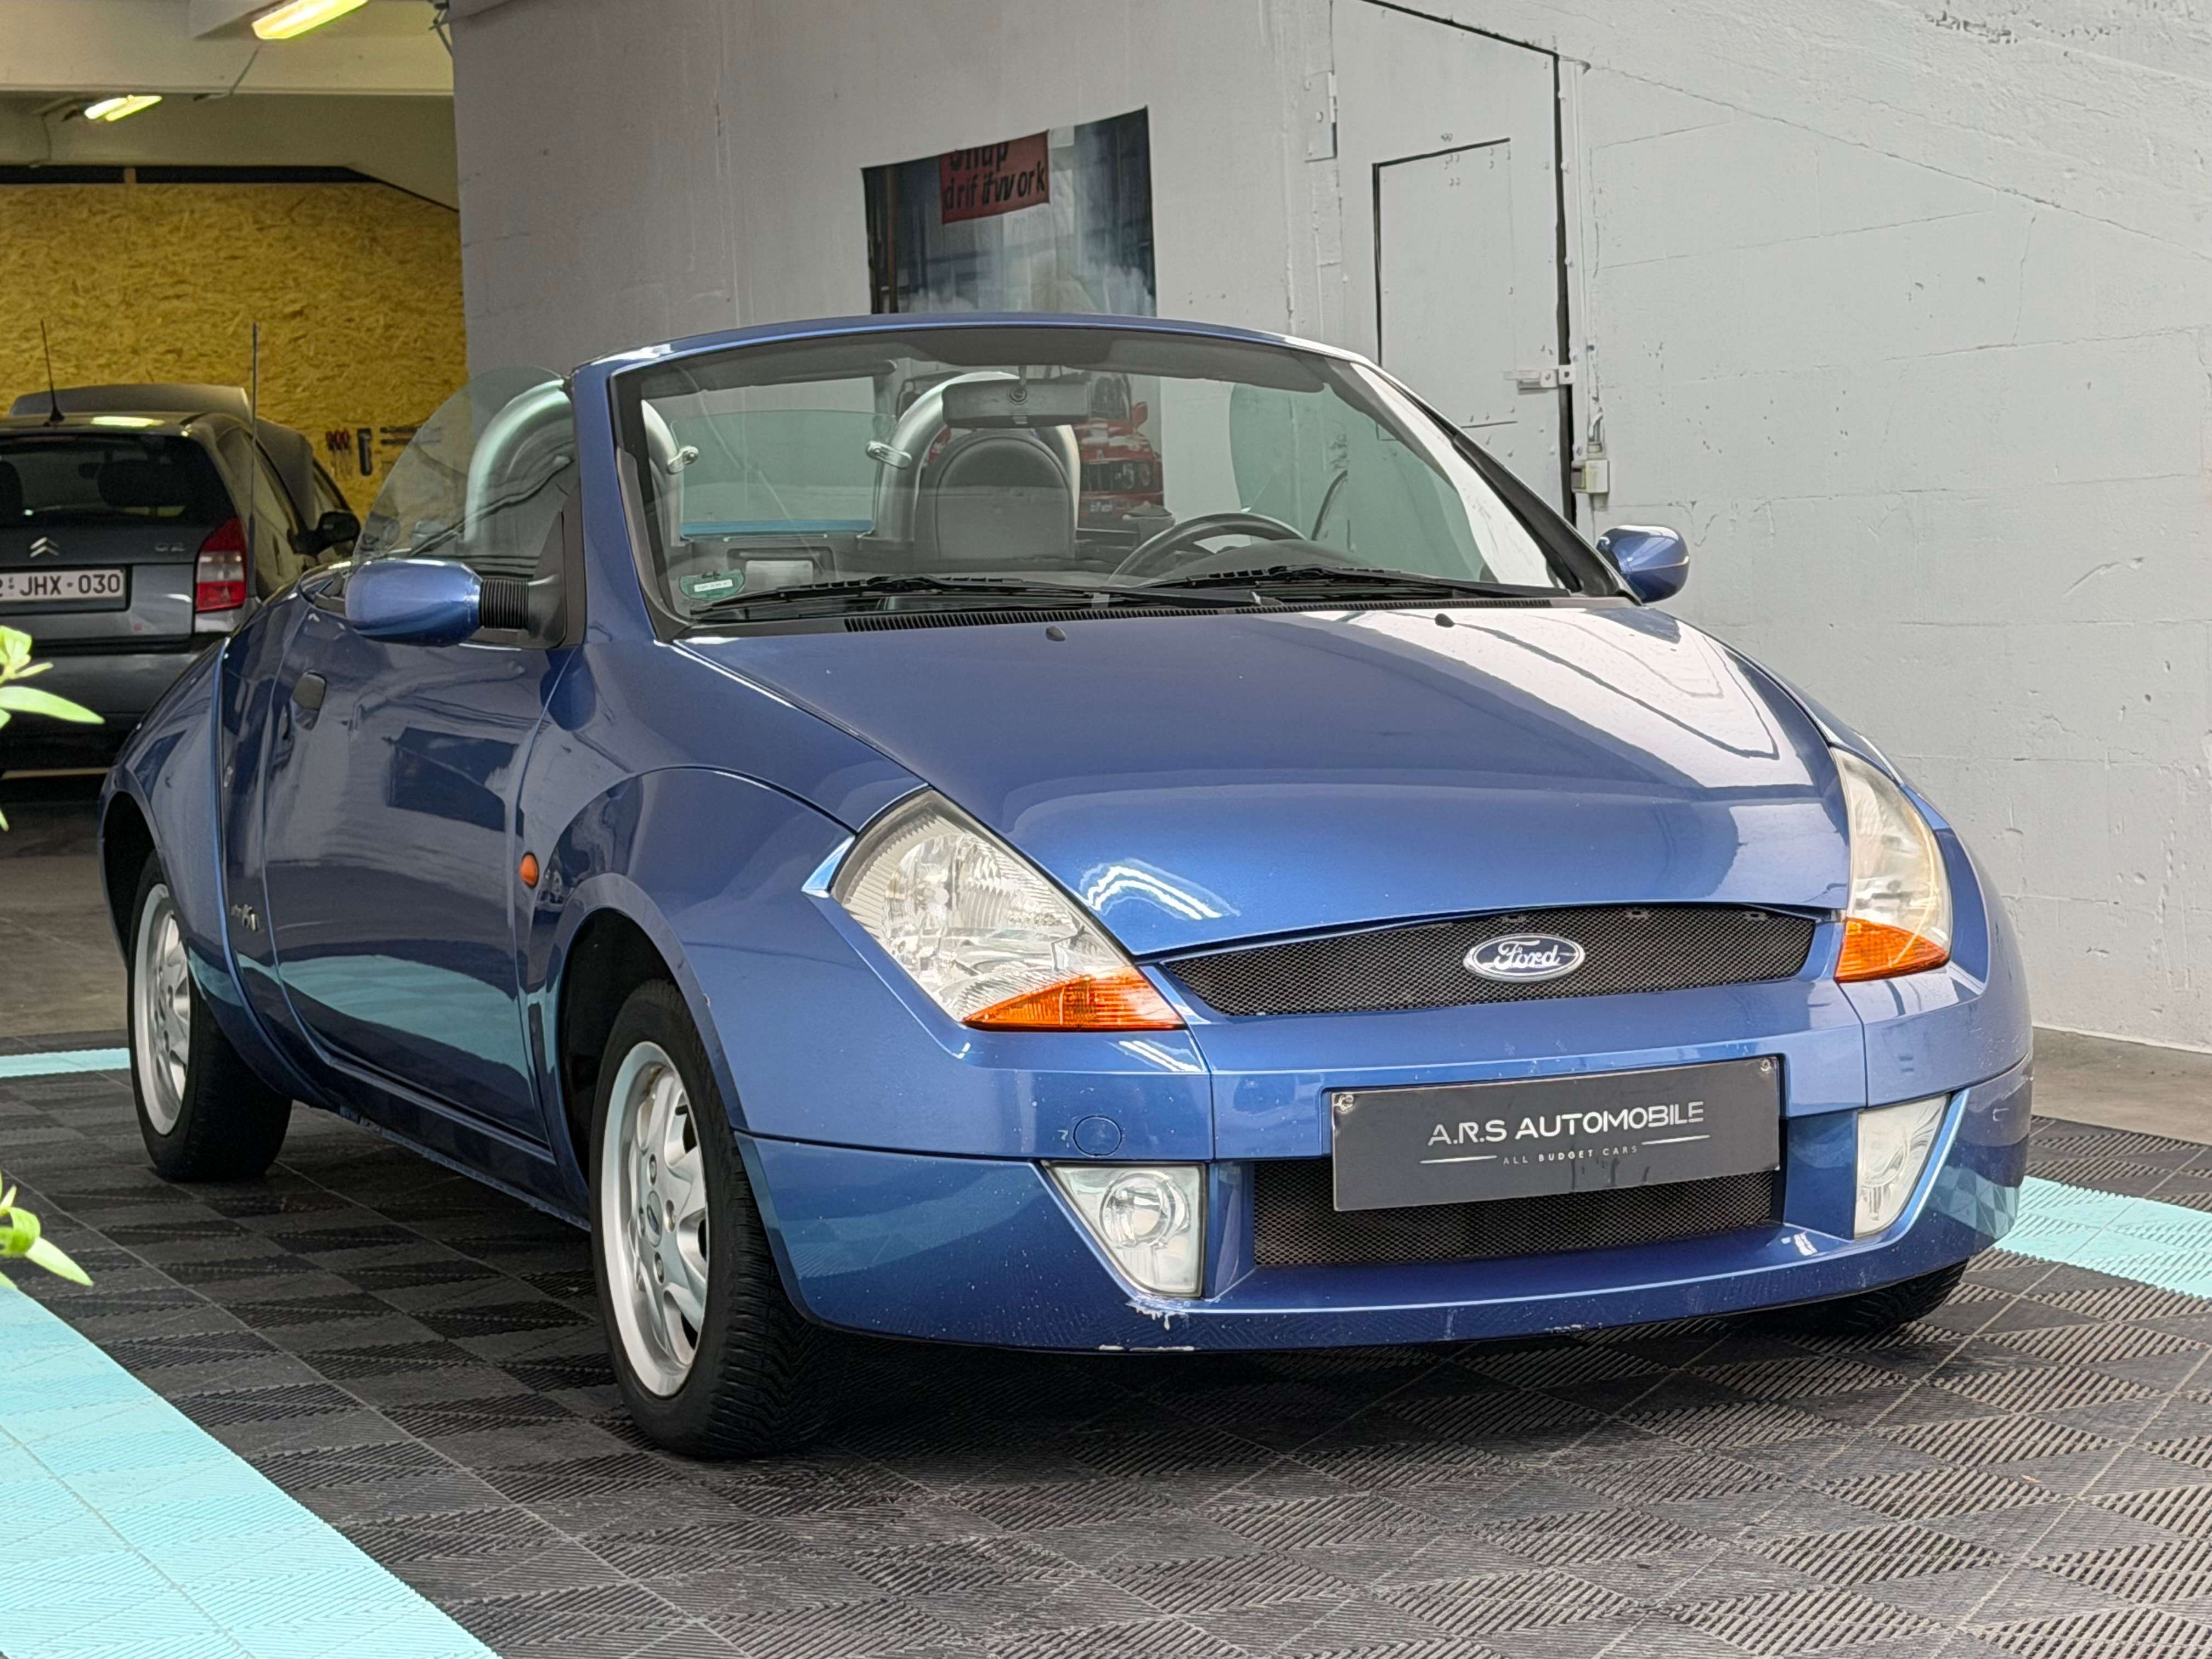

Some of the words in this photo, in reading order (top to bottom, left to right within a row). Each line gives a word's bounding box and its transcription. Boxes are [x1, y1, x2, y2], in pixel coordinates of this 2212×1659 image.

[1483, 940, 1561, 970] Ford
[1427, 1120, 1507, 1146] A.R.S
[1515, 1101, 1703, 1139] AUTOMOBILE
[1538, 1149, 1593, 1162] BUDGET
[1602, 1146, 1637, 1156] CARS
